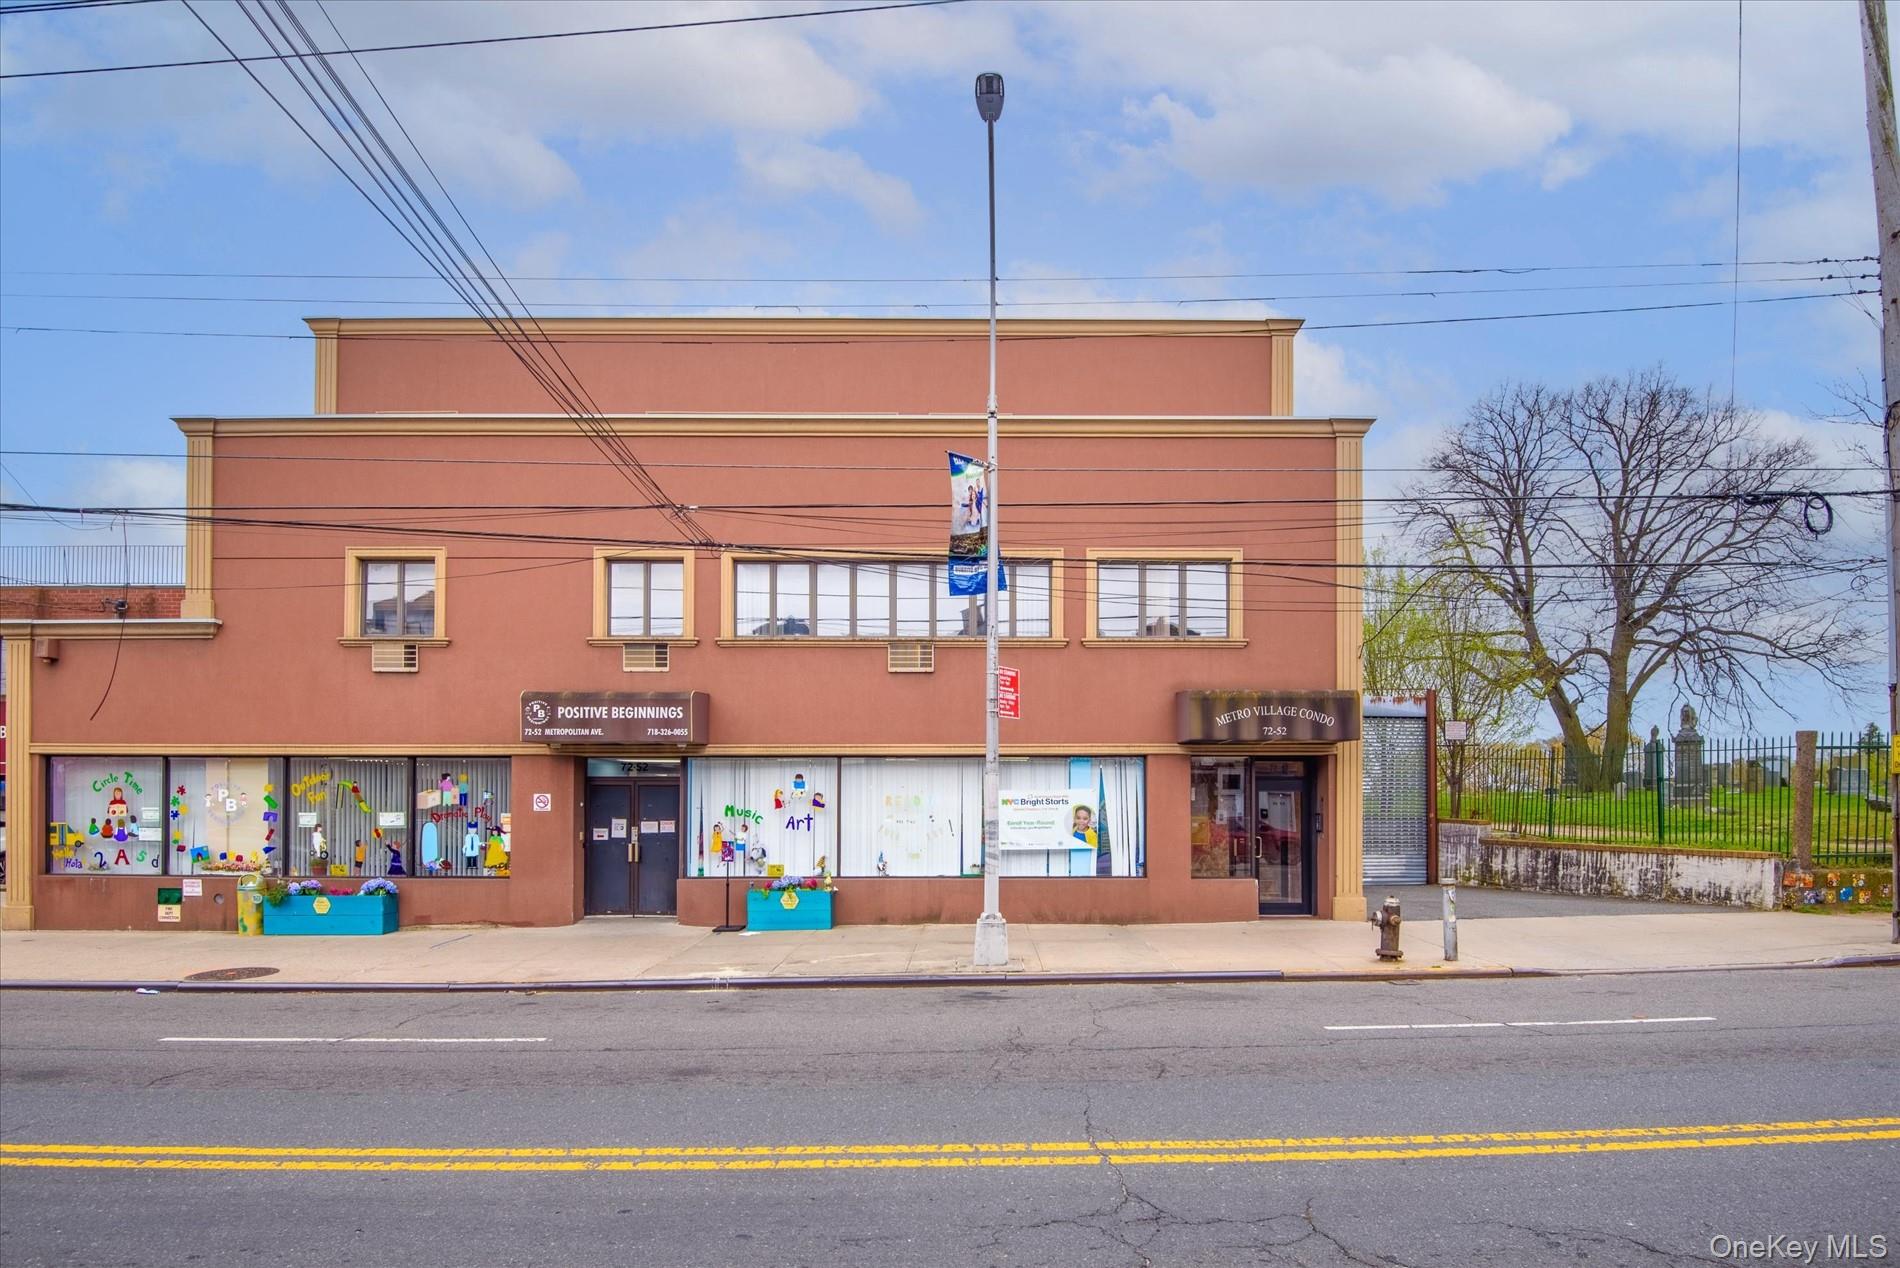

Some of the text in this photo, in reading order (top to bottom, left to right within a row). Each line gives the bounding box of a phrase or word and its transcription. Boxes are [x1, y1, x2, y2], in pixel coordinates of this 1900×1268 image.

[557, 706, 684, 719] POSITIVE BEGINNINGS
[1215, 706, 1336, 727] METRO VILLAGE CONDO
[524, 728, 605, 736] 72-52 METROPOLITAN AVE.
[647, 728, 689, 736] 718-326-0055
[1262, 726, 1288, 736] 72-52
[621, 762, 649, 772] 72-52
[92, 771, 143, 795] Circle Time
[1001, 798, 1069, 807] NYC Bright Starts
[431, 806, 493, 823] Dramatic Play
[724, 804, 764, 825] Music
[785, 813, 814, 832] Art
[114, 848, 131, 865] A
[64, 858, 83, 869] Hola
